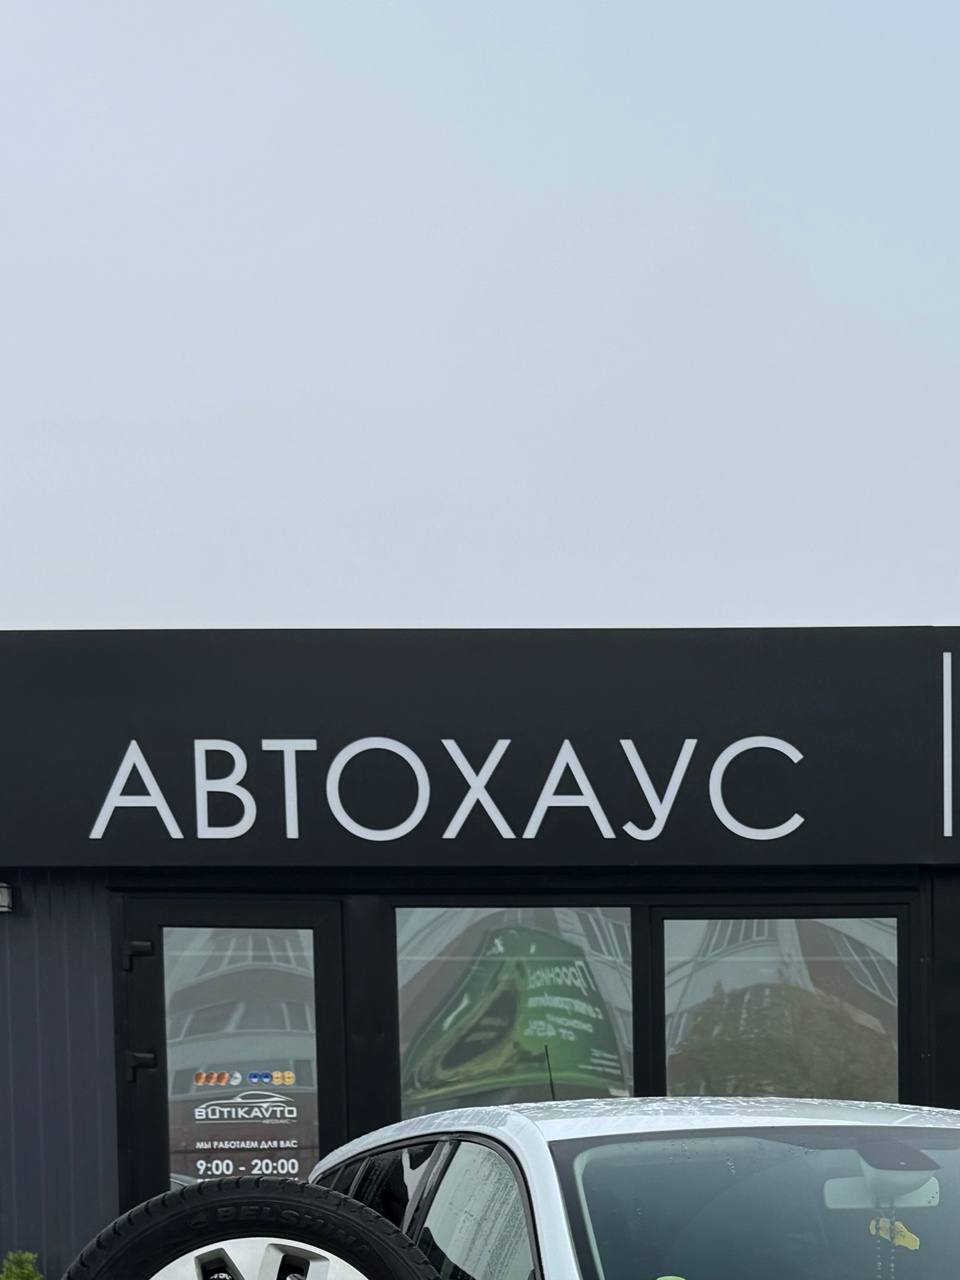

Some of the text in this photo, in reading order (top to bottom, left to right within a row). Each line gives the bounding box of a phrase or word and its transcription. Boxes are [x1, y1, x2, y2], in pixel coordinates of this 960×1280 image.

[88, 735, 806, 842] АВТОХАУС
[194, 1106, 297, 1119] BUTIKAVTO
[195, 1139, 298, 1149] МЫ РАБОТАЕМ ДЛЯ ВАС
[196, 1159, 234, 1175] 9:00
[251, 1158, 299, 1174] 20:00
